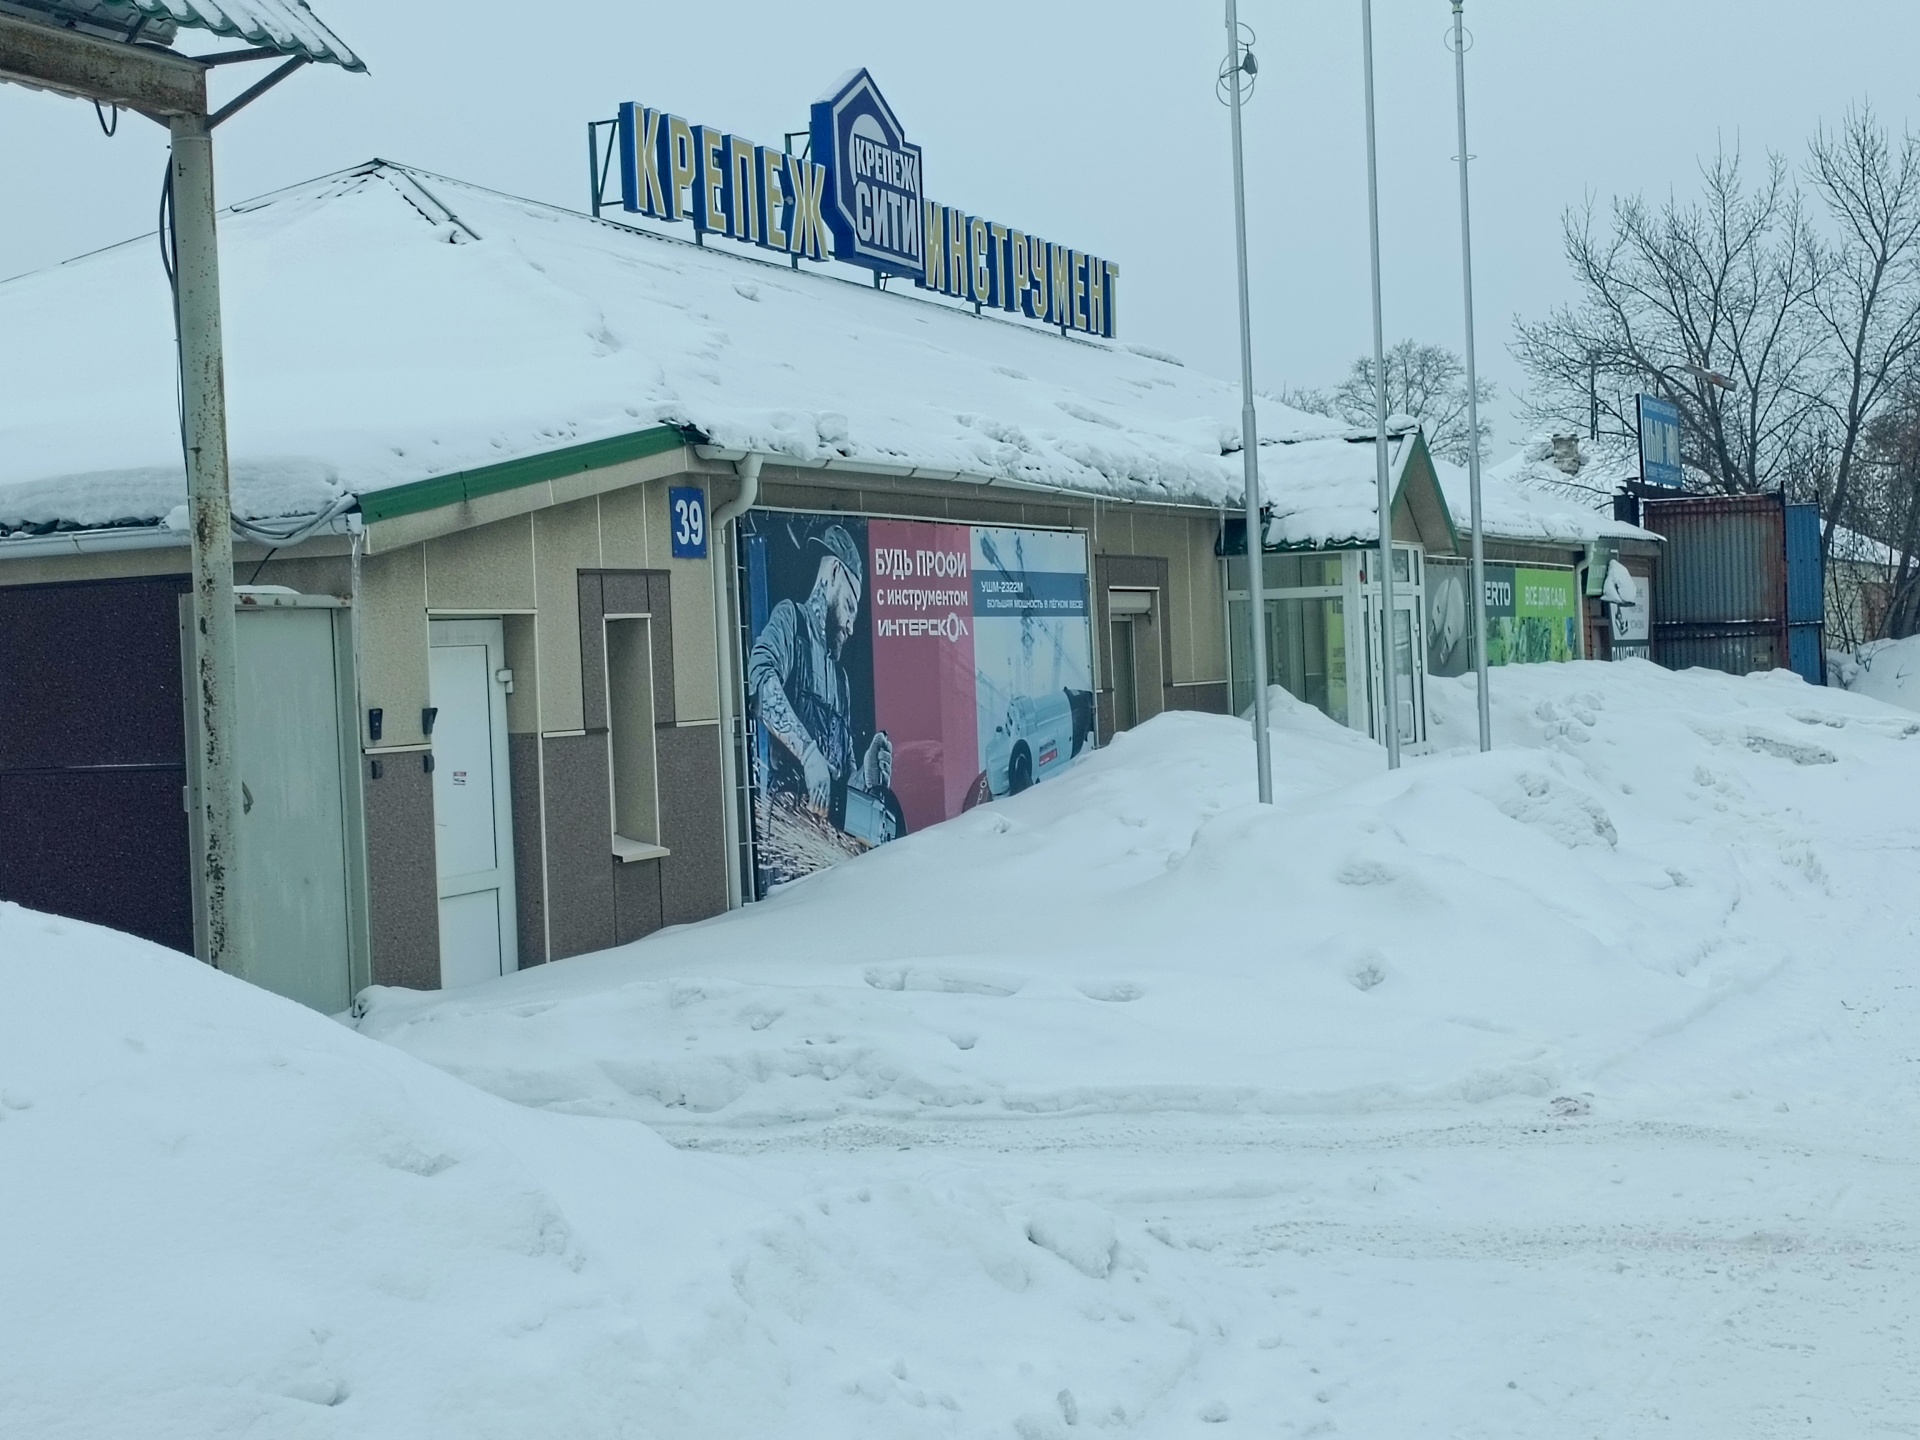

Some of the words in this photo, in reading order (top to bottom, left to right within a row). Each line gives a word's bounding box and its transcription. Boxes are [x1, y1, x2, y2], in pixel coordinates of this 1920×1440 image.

[855, 137, 916, 193] КРЕПЕЖ
[620, 101, 829, 262] КРЕПЕЖ
[855, 181, 917, 257] СИТИ
[922, 198, 1120, 338] ИНСТРУМЕНТ
[676, 499, 704, 546] 39
[875, 549, 913, 580] БУДЬ
[916, 550, 967, 578] ПРОФИ
[877, 589, 885, 605] с
[887, 589, 968, 611] инструментом
[987, 599, 1013, 609] БОЛЬШАЯ
[1014, 599, 1043, 609] МОЩНОСТЬ
[1483, 581, 1511, 607] ERTO
[1525, 586, 1537, 606] ВСЕ
[1538, 587, 1550, 610] ДЛЯ
[1551, 587, 1567, 610] САДА
[878, 612, 969, 642] ИНТЕРСКОЛ
